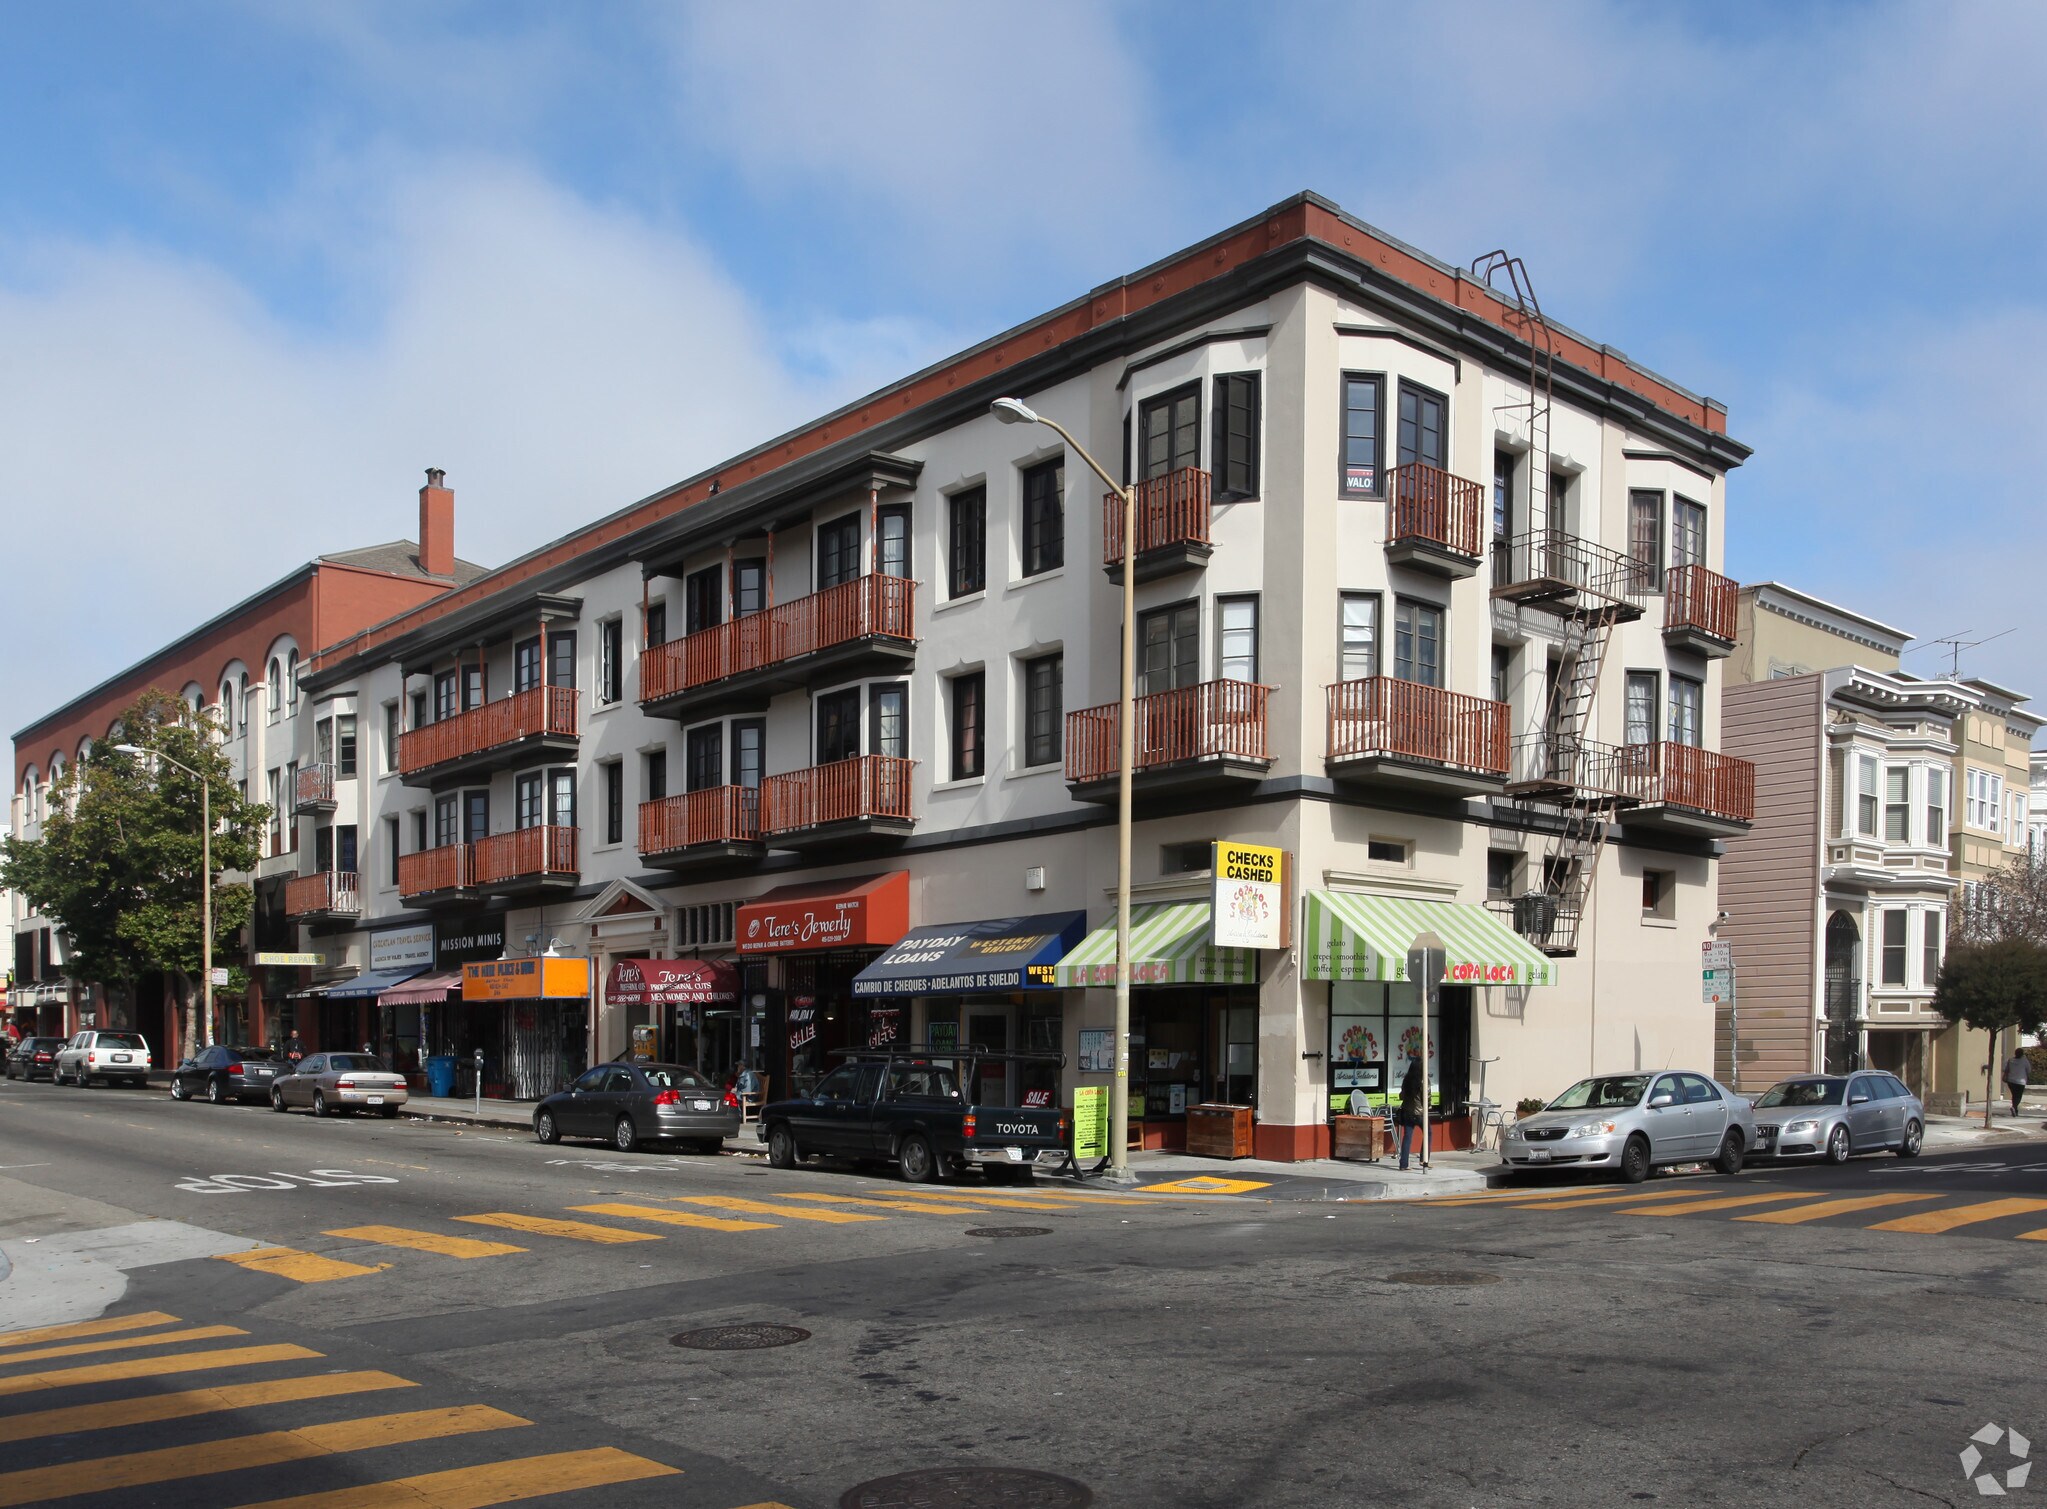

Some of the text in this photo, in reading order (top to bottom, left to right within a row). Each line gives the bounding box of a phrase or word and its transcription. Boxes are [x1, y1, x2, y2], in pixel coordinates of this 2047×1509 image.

[1227, 850, 1274, 869] CHECKS
[1226, 865, 1273, 883] CASHED
[1229, 885, 1269, 919] LA COPA LOCA
[764, 909, 852, 942] Tere's Jewerly
[396, 935, 413, 945] TRAVEL
[413, 932, 432, 943] SERVICE
[440, 933, 502, 951] MISSION MINIS
[896, 935, 968, 951] PAYDAY
[969, 935, 1035, 949] WESTERN
[1326, 938, 1346, 949] gelato
[980, 943, 1028, 955] UNION
[1702, 942, 1711, 950] NO
[263, 955, 322, 963] SHOE REPAIRS
[883, 950, 945, 965] LOANS
[1312, 952, 1369, 962] crepes smoothies
[617, 963, 640, 982] Tere's
[658, 970, 702, 982] Tere's
[1028, 966, 1055, 976] WEST
[1072, 966, 1089, 983] LA
[1092, 965, 1117, 983] COP
[1129, 962, 1169, 981] LOCA
[1312, 963, 1370, 975] coffee espresso
[1396, 963, 1409, 979] gel
[1452, 962, 1481, 980] COPA
[1484, 964, 1515, 981] LOCA
[1527, 968, 1548, 983] gelato
[650, 981, 712, 991] PROFESSIONAL CUTS
[854, 972, 1019, 994] CAMBIO DE CHEQUES ADELANTOS DE SUELDO
[666, 993, 690, 1001] WOMEN
[691, 992, 705, 1001] AND
[706, 991, 735, 1001] CHILDREN
[931, 1024, 957, 1037] PAYDAY
[1338, 1025, 1379, 1061] LA COPA LOCA
[1026, 1091, 1050, 1105] SALE
[996, 1123, 1039, 1135] TOYOTA
[174, 1169, 400, 1194] STOP
